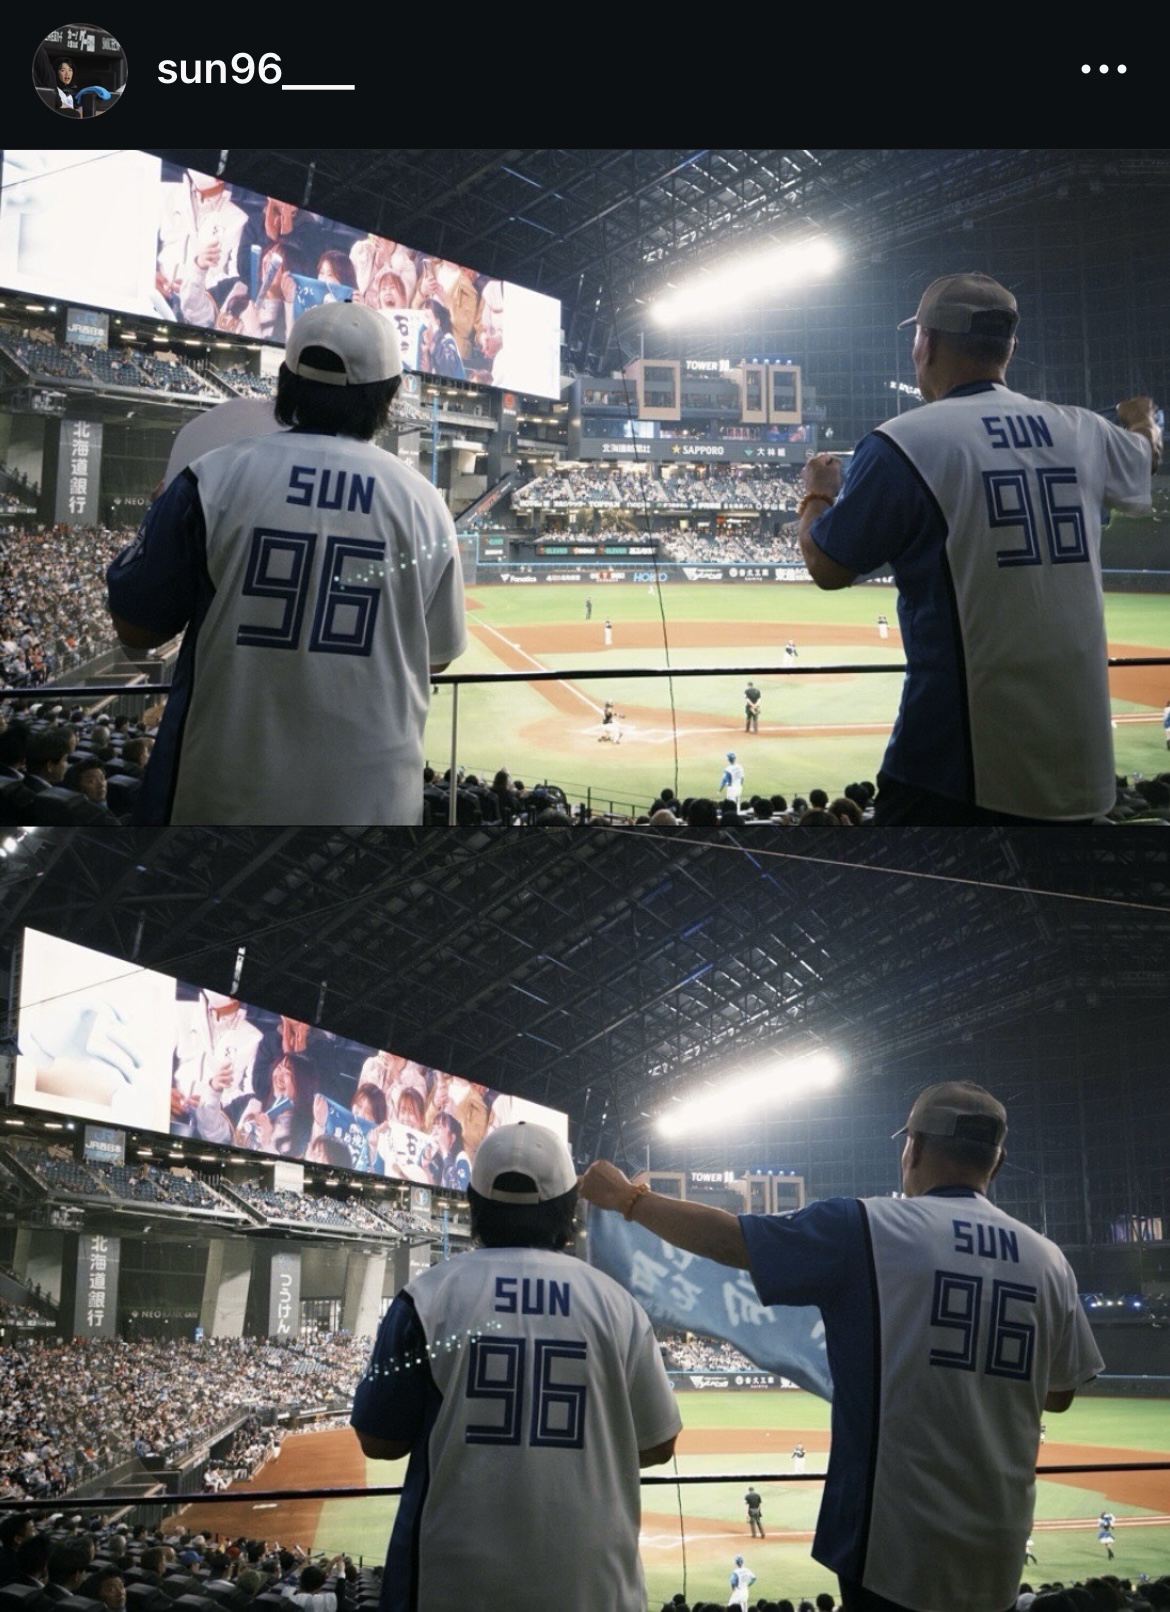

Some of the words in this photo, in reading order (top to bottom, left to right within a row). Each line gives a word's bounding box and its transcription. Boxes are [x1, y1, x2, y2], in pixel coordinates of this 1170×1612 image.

[685, 360, 718, 371] TOWER
[682, 445, 725, 456] SAPPORO
[981, 415, 1054, 449] SUN
[68, 421, 91, 514] 北海道銀行
[286, 465, 376, 514] SUN
[982, 467, 1090, 568] 96
[236, 527, 386, 656] 96
[691, 1172, 722, 1182] TOWER
[952, 1219, 1020, 1263] SUN
[86, 1235, 108, 1327] 北海道銀行
[277, 1274, 293, 1334] つうけん
[495, 1277, 570, 1317] SUN
[929, 1270, 1037, 1382] 96
[465, 1335, 587, 1449] 96
